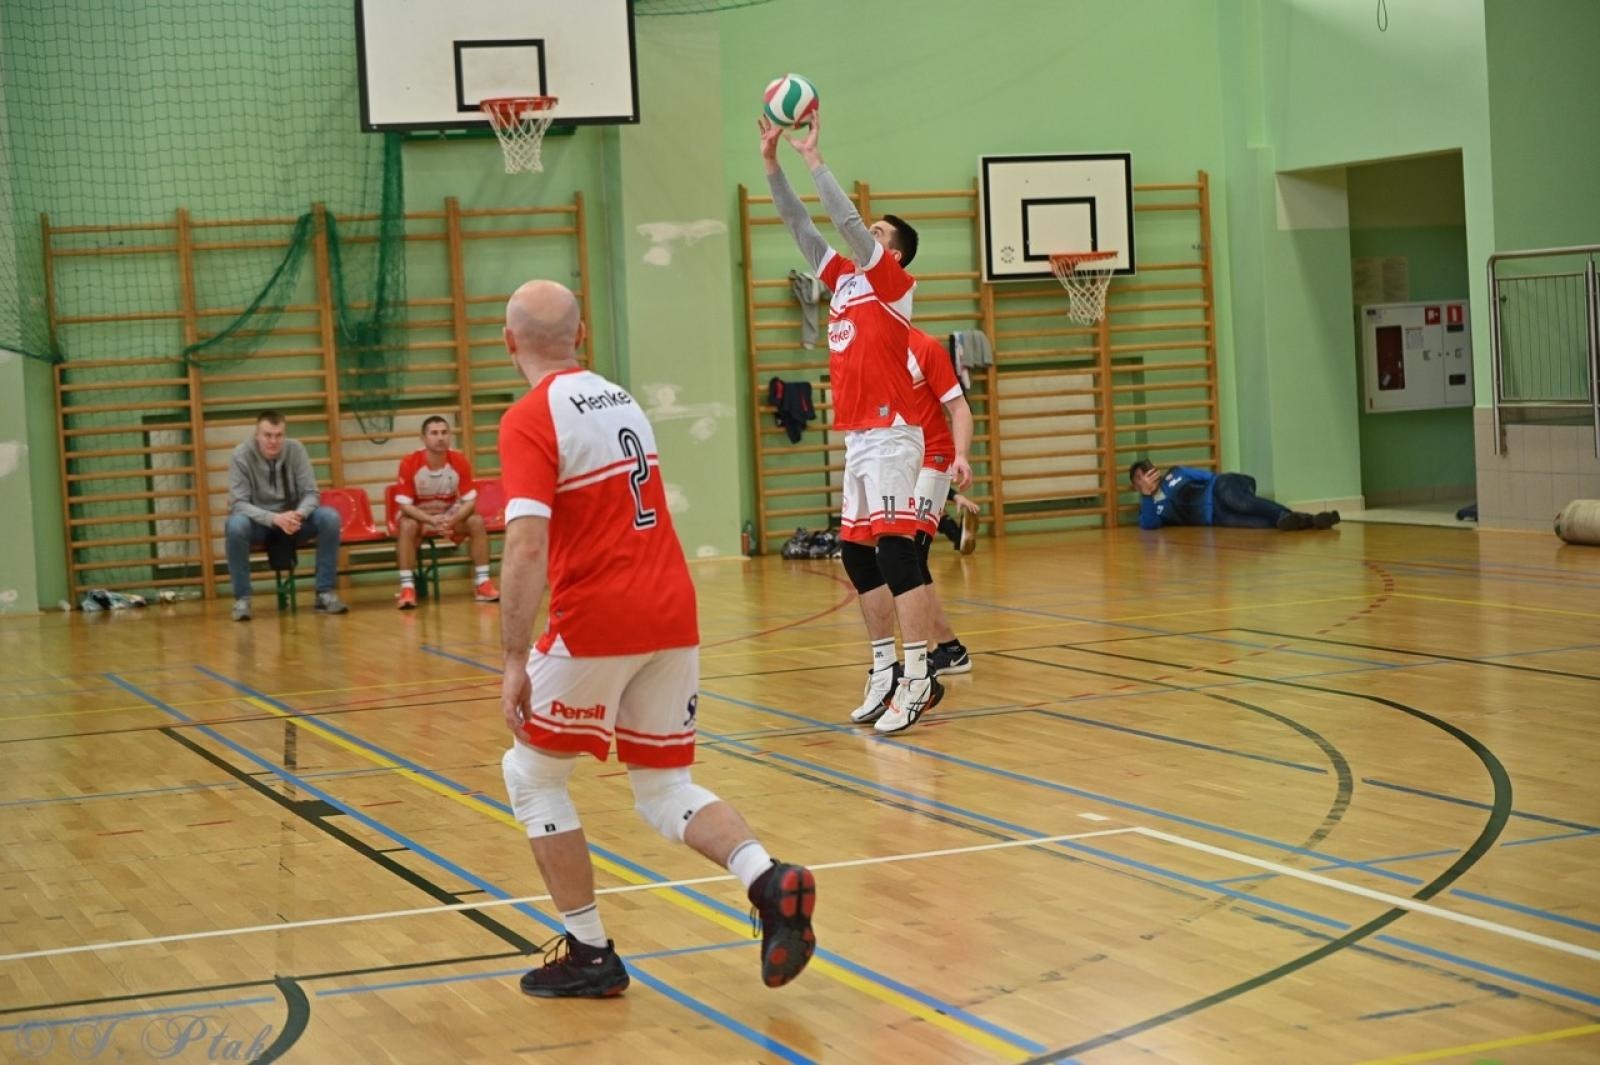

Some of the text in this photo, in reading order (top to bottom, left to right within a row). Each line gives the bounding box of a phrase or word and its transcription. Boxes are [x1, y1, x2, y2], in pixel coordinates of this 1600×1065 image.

[618, 427, 656, 530] 2
[882, 495, 896, 523] 11
[550, 699, 606, 721] Persil
